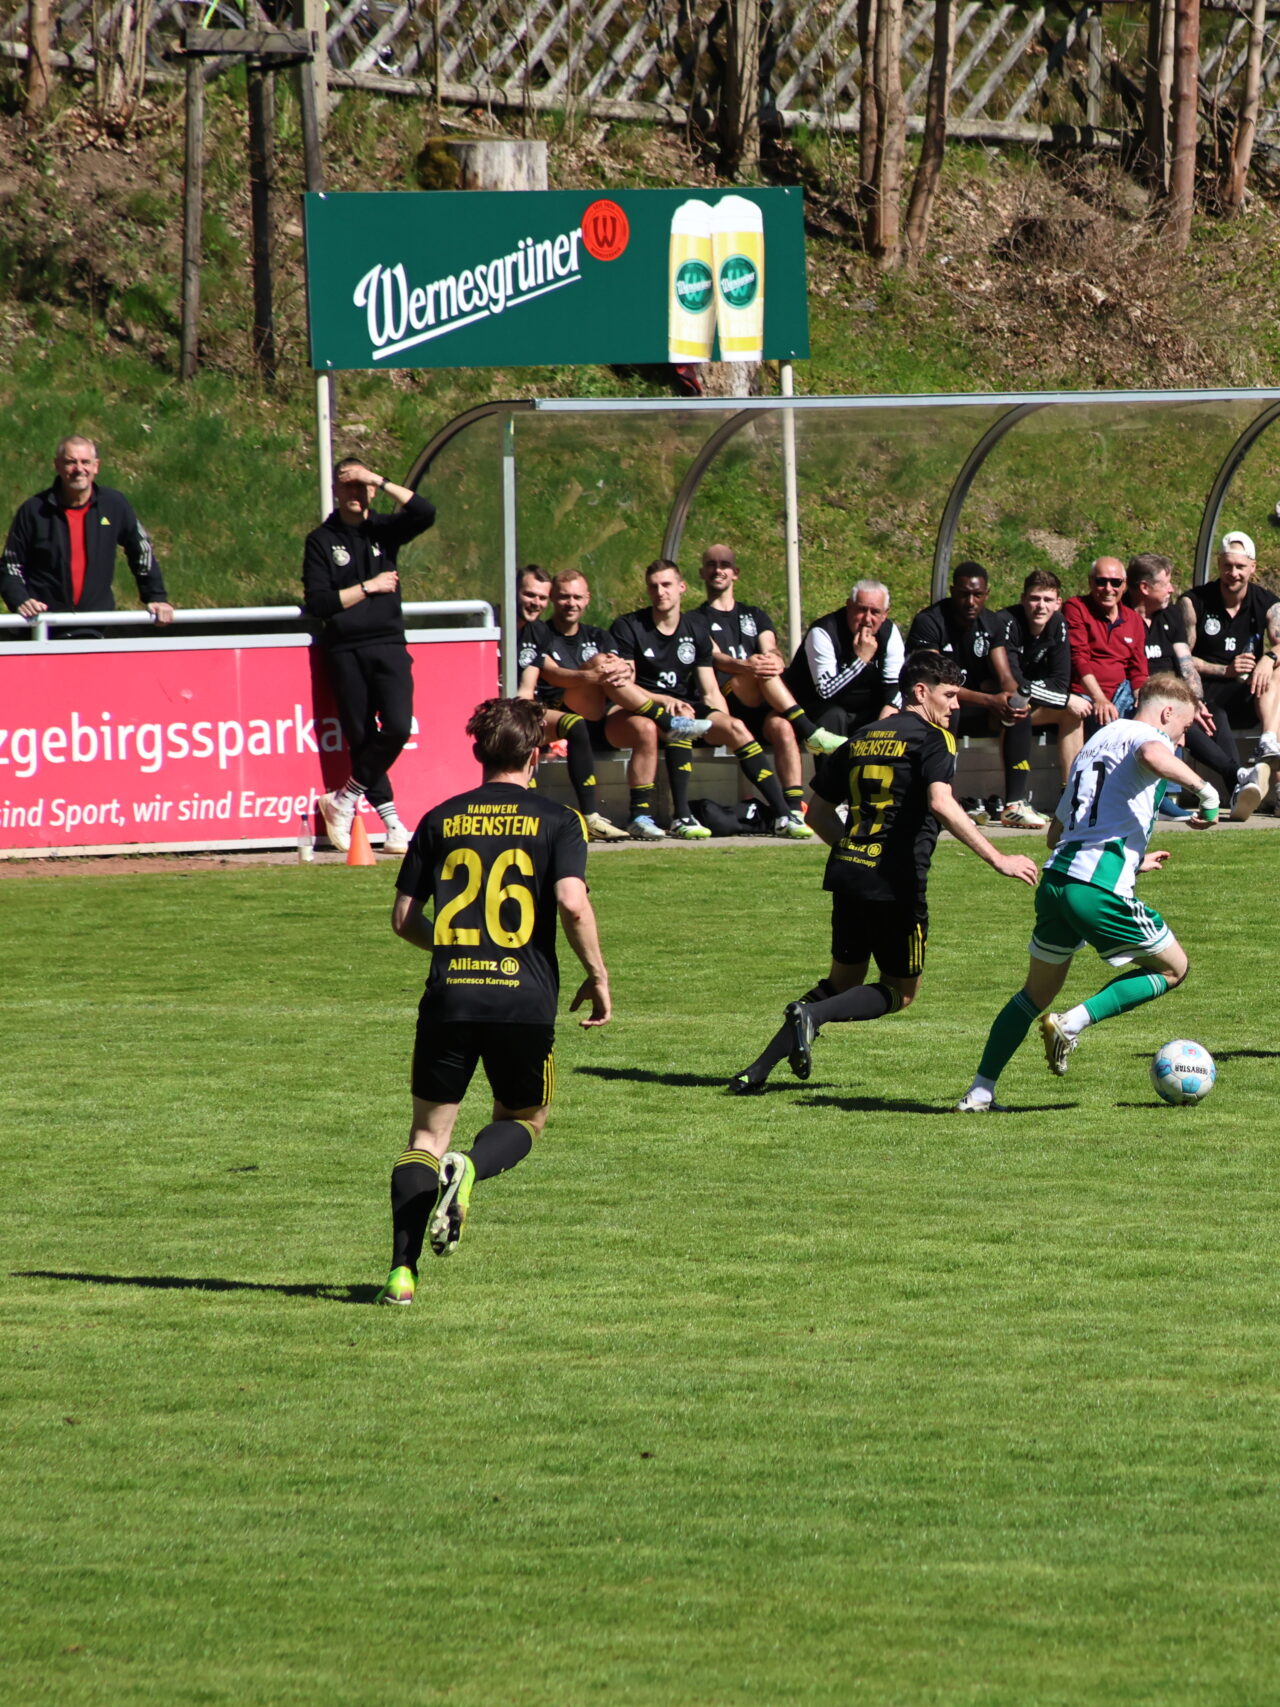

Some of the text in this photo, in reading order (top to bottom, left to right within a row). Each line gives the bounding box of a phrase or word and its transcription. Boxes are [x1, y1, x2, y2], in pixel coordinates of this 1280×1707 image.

[353, 228, 582, 347] Wernesgrüner
[1224, 637, 1237, 652] 16
[0, 704, 419, 778] gebirgssparka
[0, 798, 43, 828] ind
[49, 798, 125, 832] Sport,
[133, 794, 173, 823] wir
[177, 791, 232, 822] sind
[467, 804, 519, 814] HANDWERK
[1069, 761, 1106, 831] 11
[443, 814, 539, 838] RABENSTEIN
[434, 848, 534, 949] 26
[448, 957, 498, 971] Allianz
[446, 977, 520, 988] Francesco Karnapp
